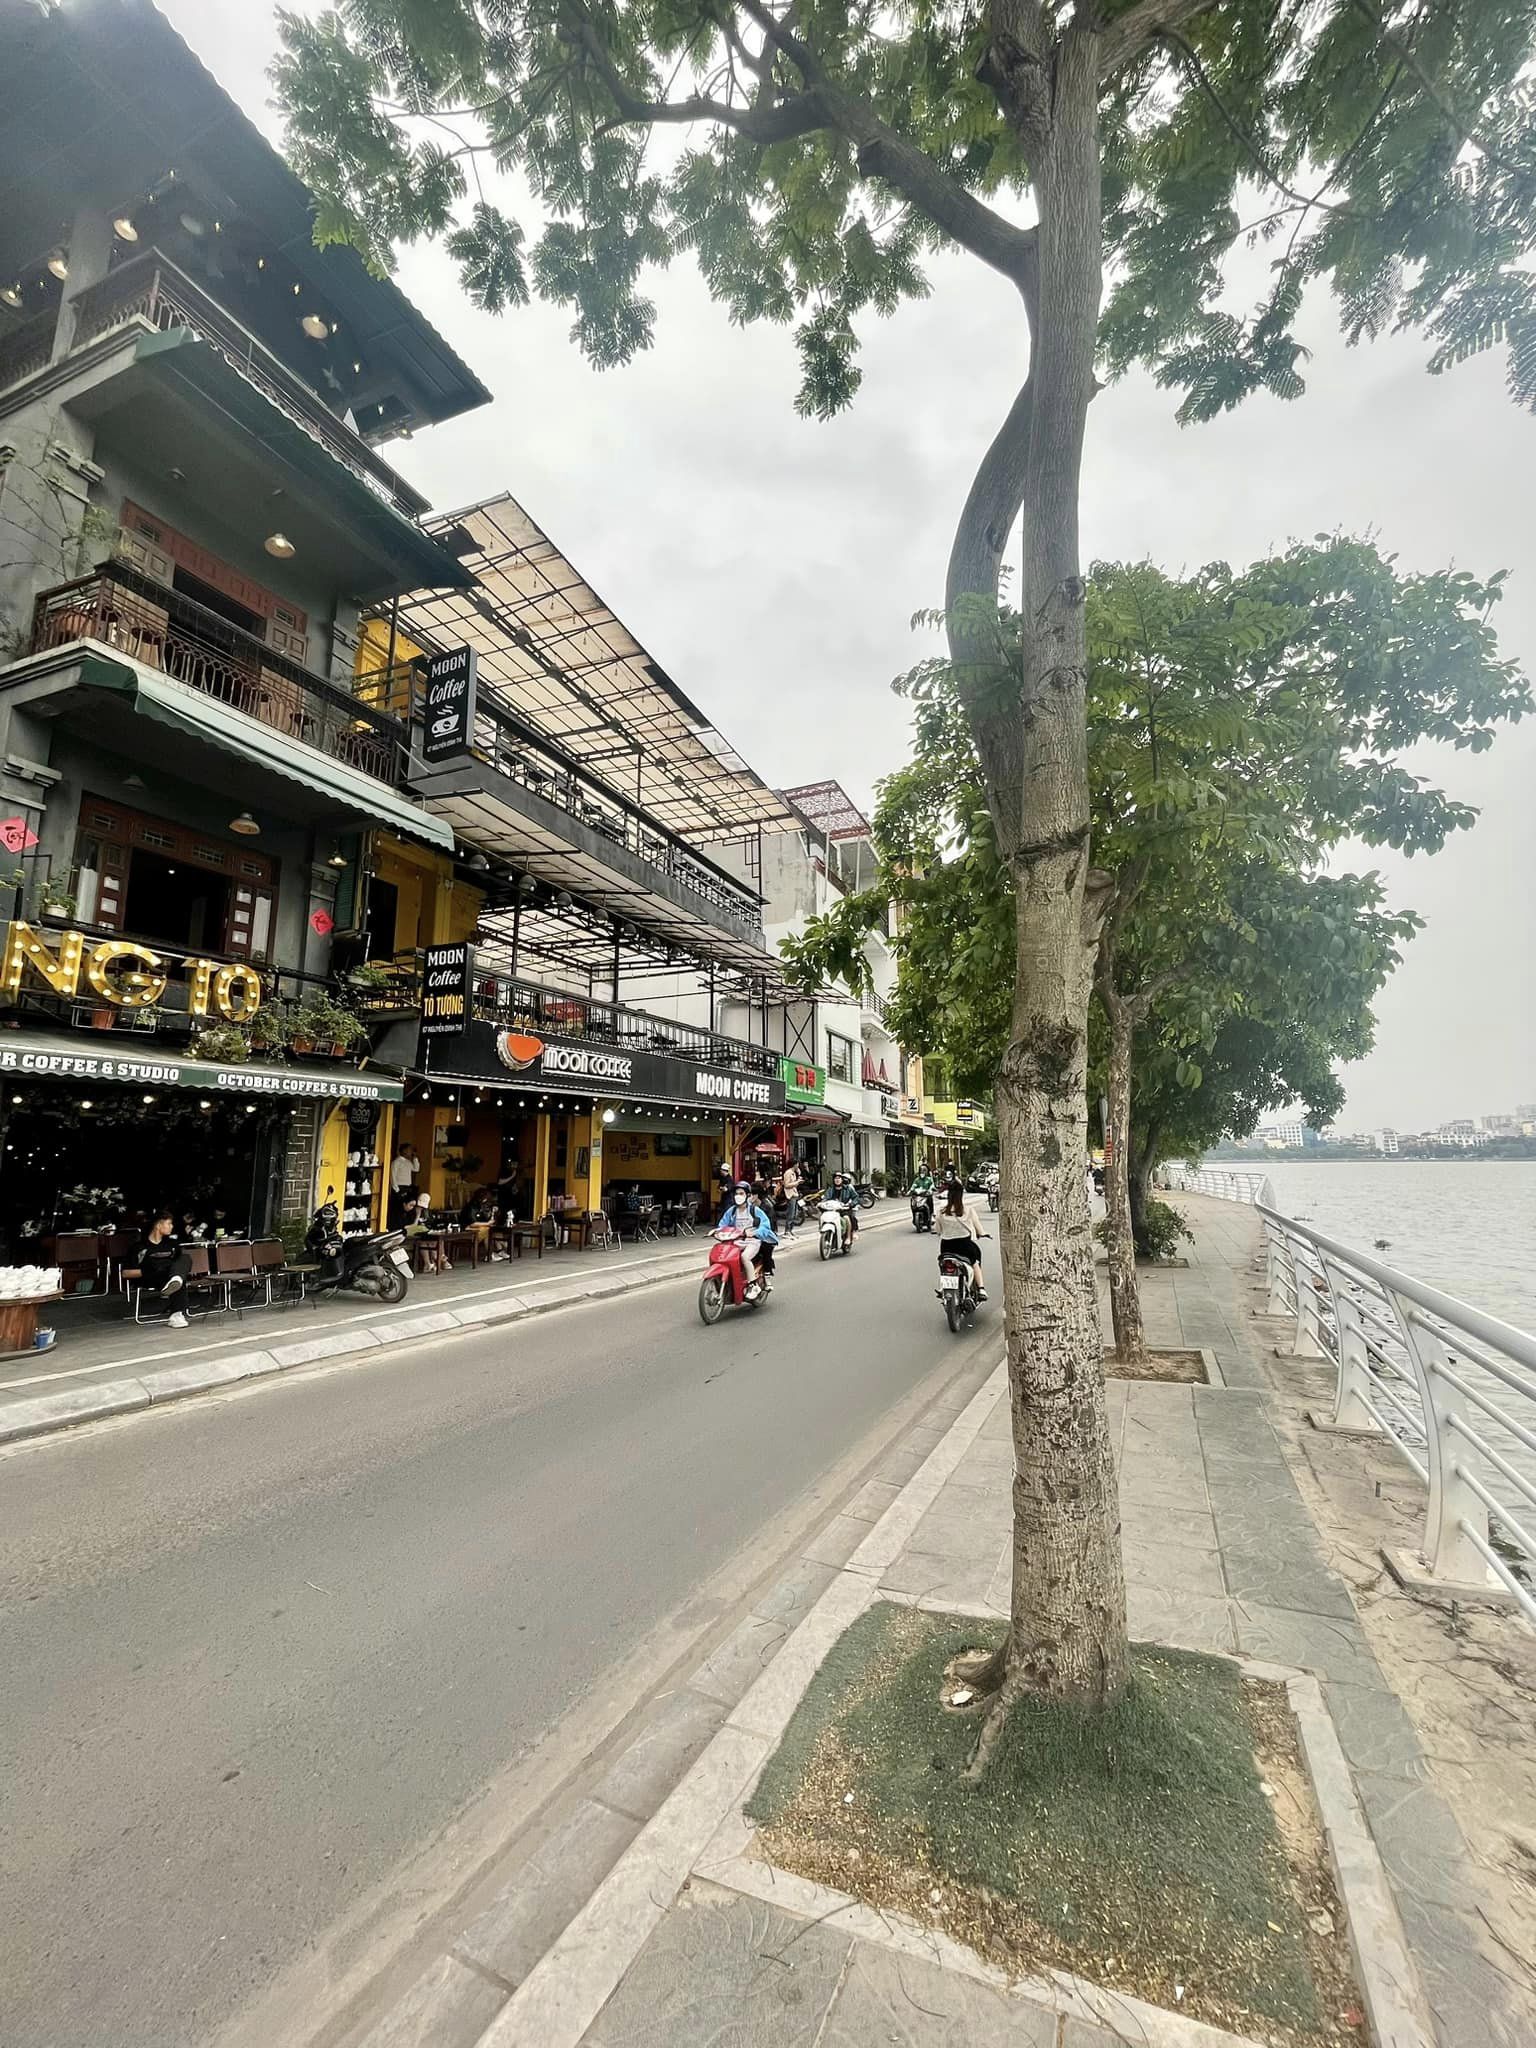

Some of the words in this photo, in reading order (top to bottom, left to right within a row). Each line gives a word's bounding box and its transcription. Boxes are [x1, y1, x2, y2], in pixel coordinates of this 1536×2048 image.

[431, 652, 467, 678] MOON
[429, 678, 466, 705] Coffee
[428, 948, 464, 967] MOON
[0, 920, 167, 1007] NG
[181, 957, 261, 1022] 10
[428, 969, 462, 987] Coffee
[0, 1052, 17, 1067] R
[22, 1054, 98, 1074] COFFEE
[101, 1061, 113, 1075] &
[117, 1063, 180, 1081] STUDIO
[590, 1056, 632, 1079] COFFEE
[217, 1073, 281, 1090] OCTOBER
[282, 1079, 328, 1093] COFFEE
[329, 1083, 338, 1094] &
[339, 1084, 379, 1097] STUDIO
[696, 1071, 731, 1098] MOON
[733, 1079, 770, 1103] COFFEE
